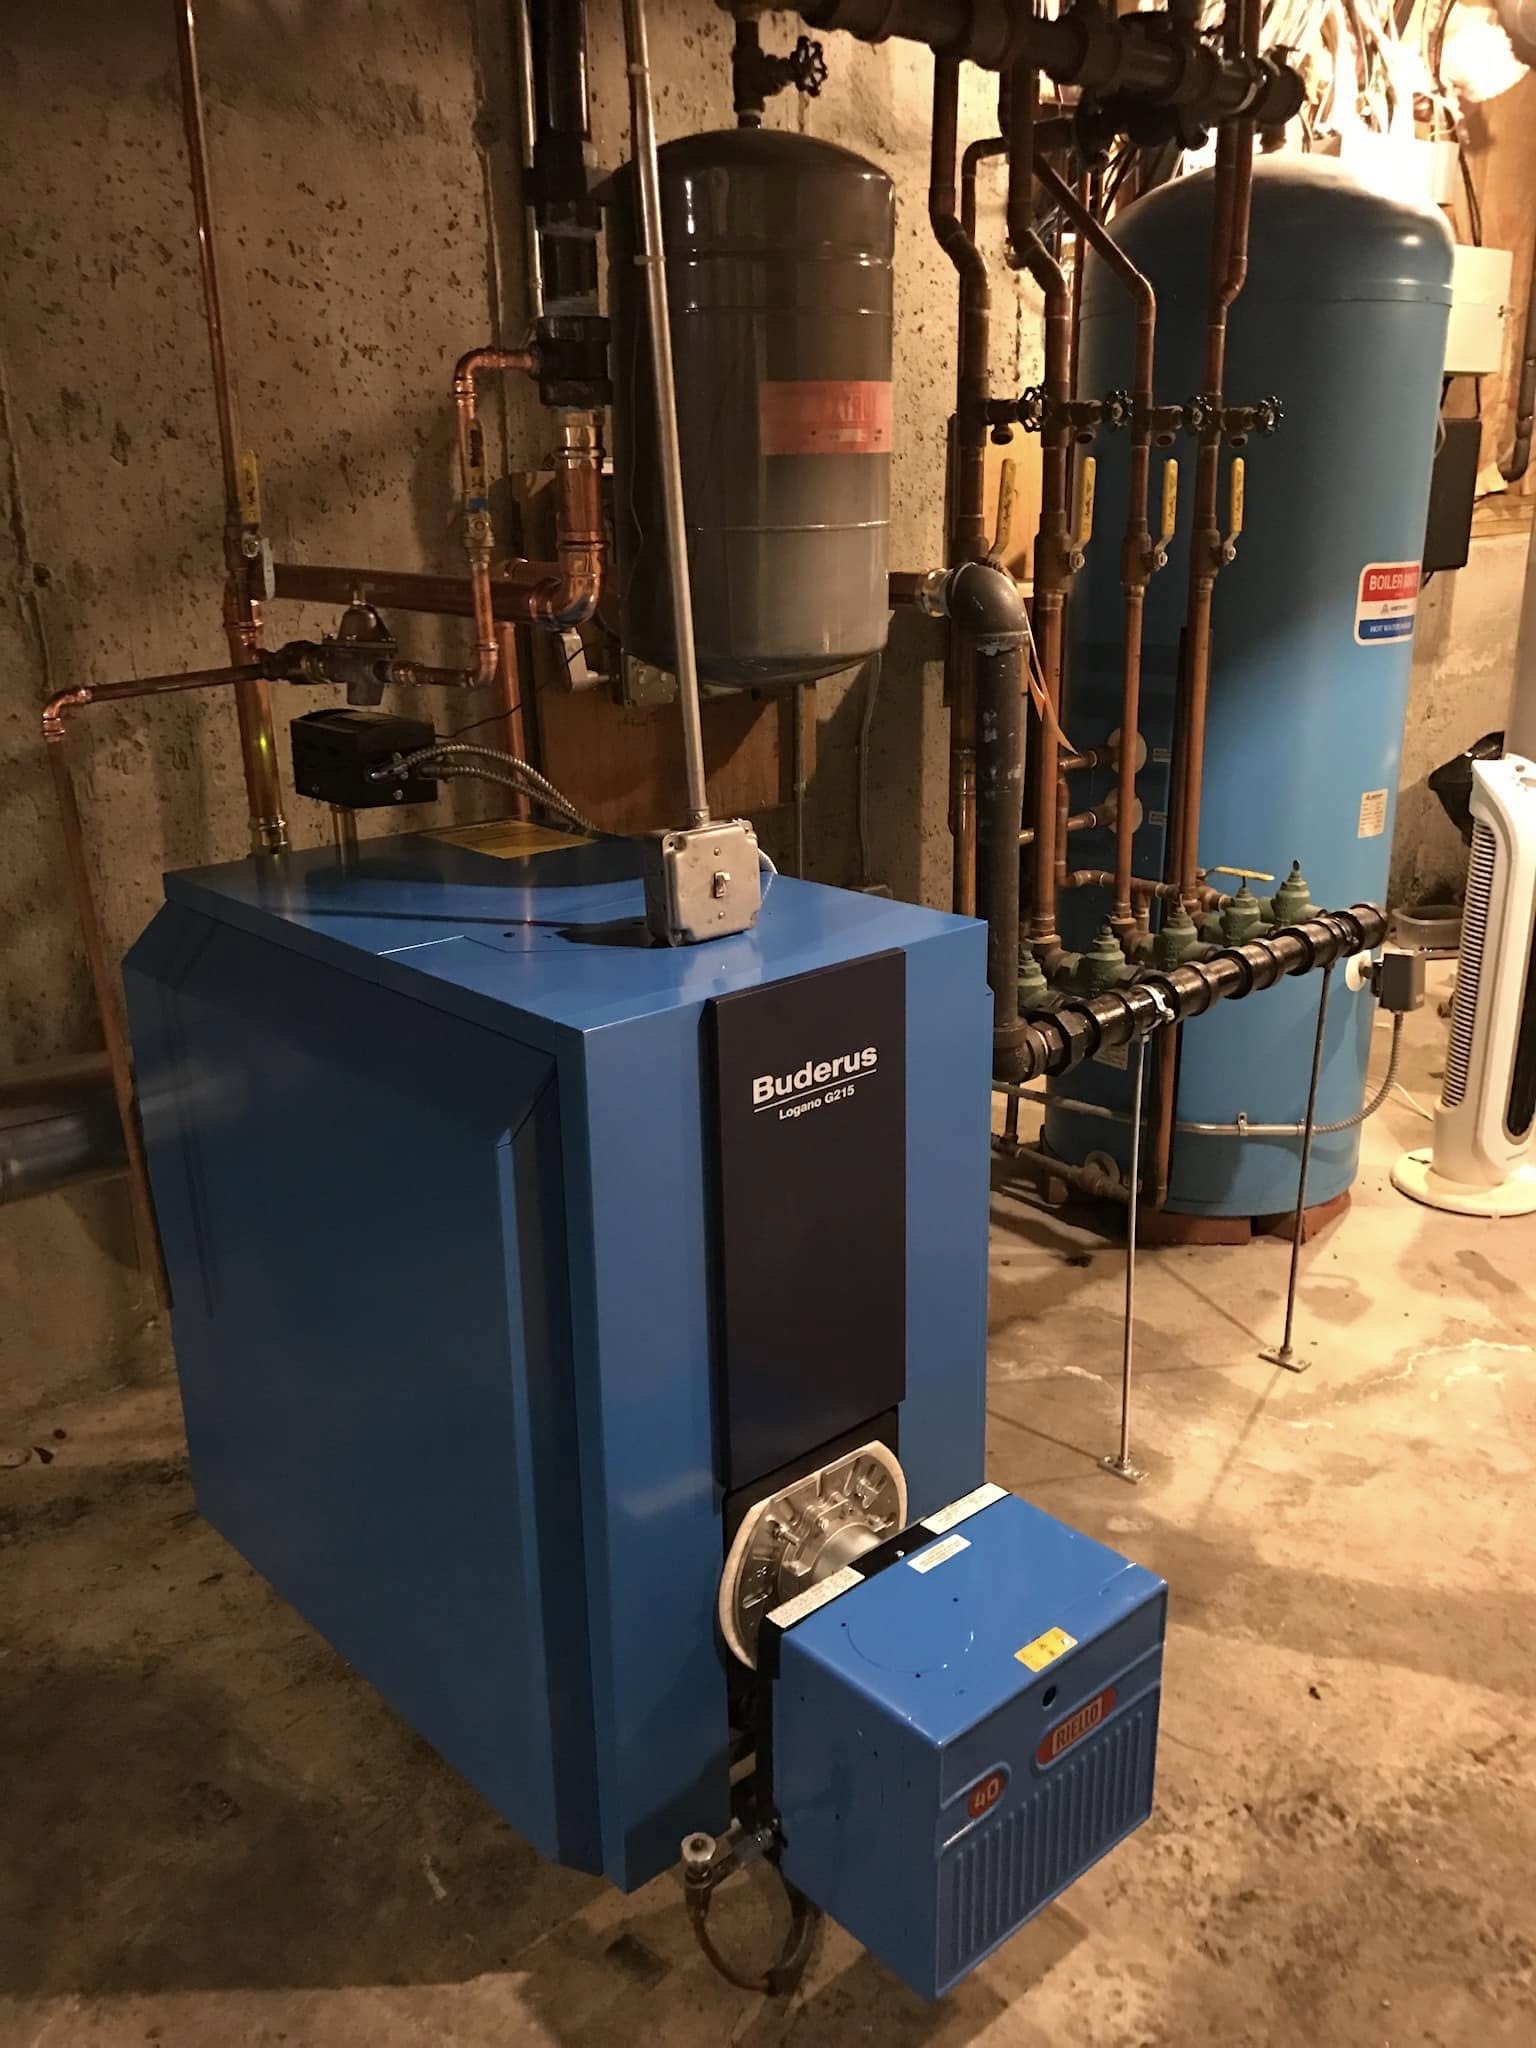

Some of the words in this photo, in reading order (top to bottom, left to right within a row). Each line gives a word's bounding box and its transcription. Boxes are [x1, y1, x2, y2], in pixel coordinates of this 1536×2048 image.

[1369, 574, 1403, 591] BOILER
[753, 1046, 878, 1105] Buderus
[779, 1098, 822, 1120] Logano
[824, 1084, 855, 1104] G215
[1054, 1702, 1101, 1751] RIELLO
[974, 1777, 1000, 1809] 40
